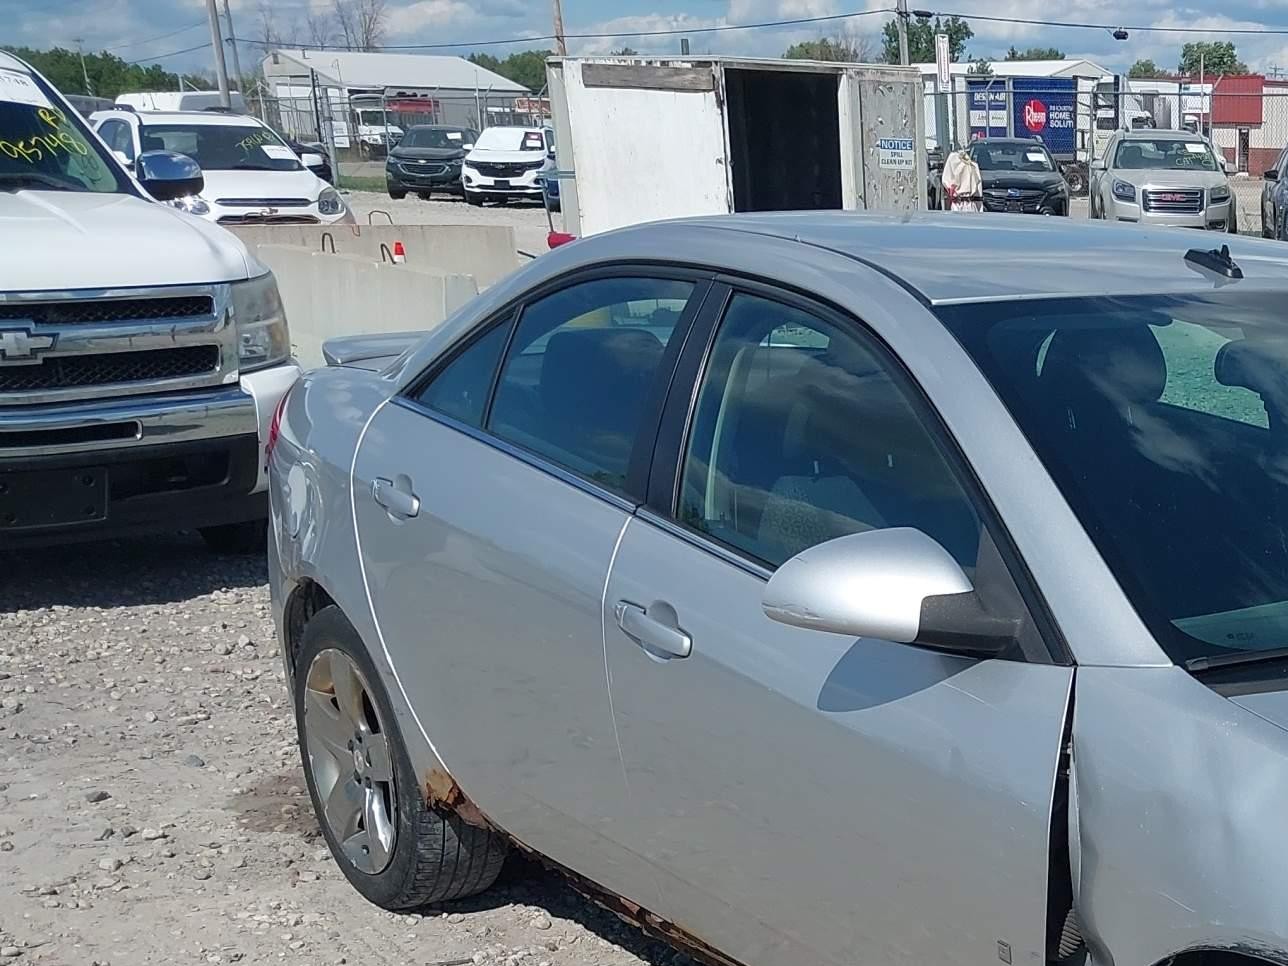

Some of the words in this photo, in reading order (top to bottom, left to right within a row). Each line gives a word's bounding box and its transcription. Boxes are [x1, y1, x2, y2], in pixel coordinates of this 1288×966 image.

[1025, 100, 1046, 127] Rheem
[1049, 111, 1071, 120] HOME
[881, 139, 912, 150] NOTICE
[1160, 192, 1187, 202] GMC
